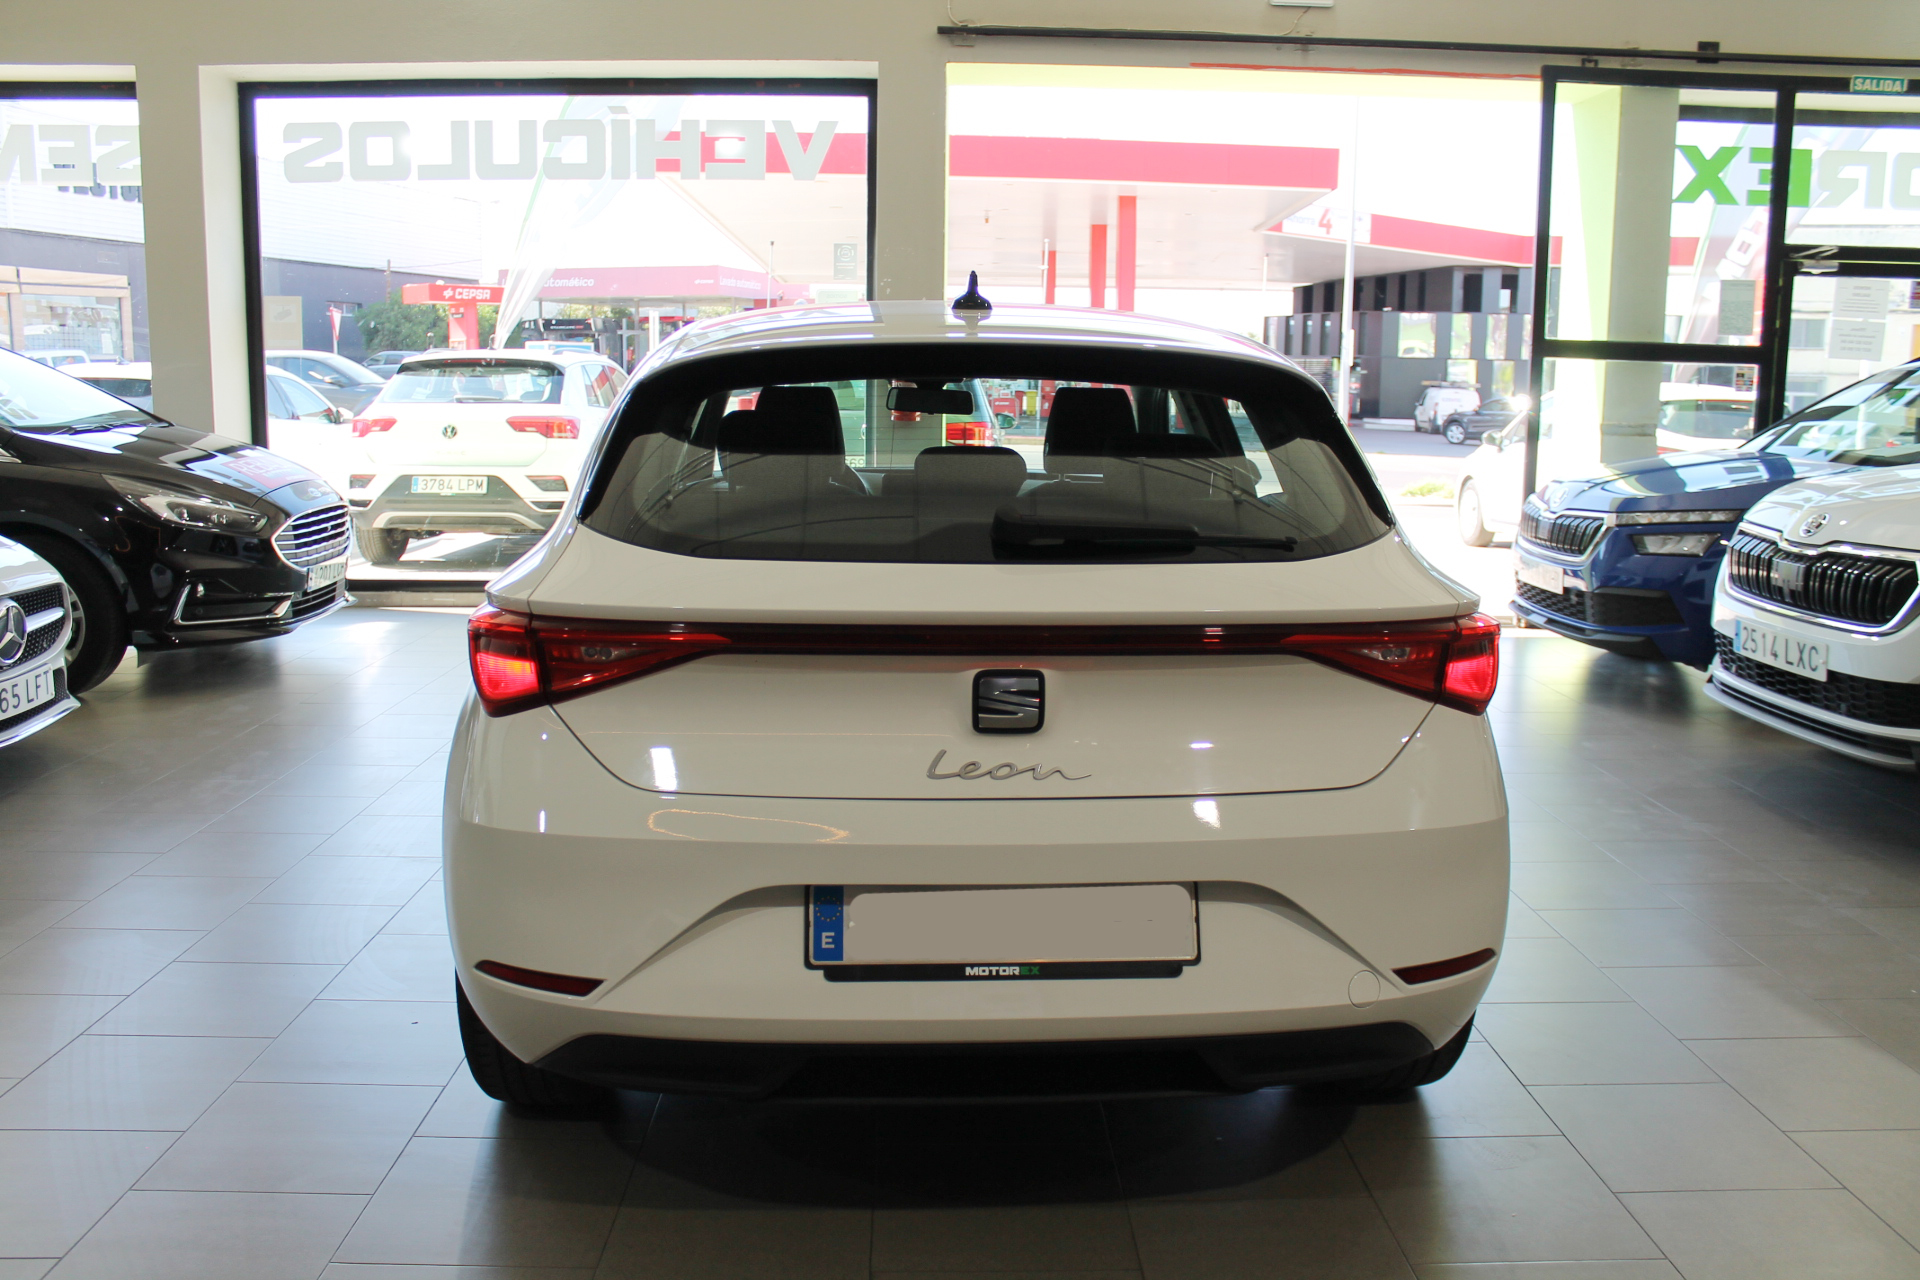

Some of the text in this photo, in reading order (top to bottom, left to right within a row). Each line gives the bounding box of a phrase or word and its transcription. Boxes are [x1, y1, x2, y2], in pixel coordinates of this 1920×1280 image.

[1854, 78, 1902, 92] SALIDA
[1318, 208, 1333, 235] 4
[543, 277, 594, 287] utomático
[455, 288, 491, 300] CEPSA
[420, 478, 484, 491] 3784 LPM
[1741, 626, 1820, 673] 2514 LXC
[26, 670, 49, 703] LFT
[926, 749, 1092, 781] Leon
[821, 932, 835, 949] E
[965, 966, 1040, 977] MOTOREX
